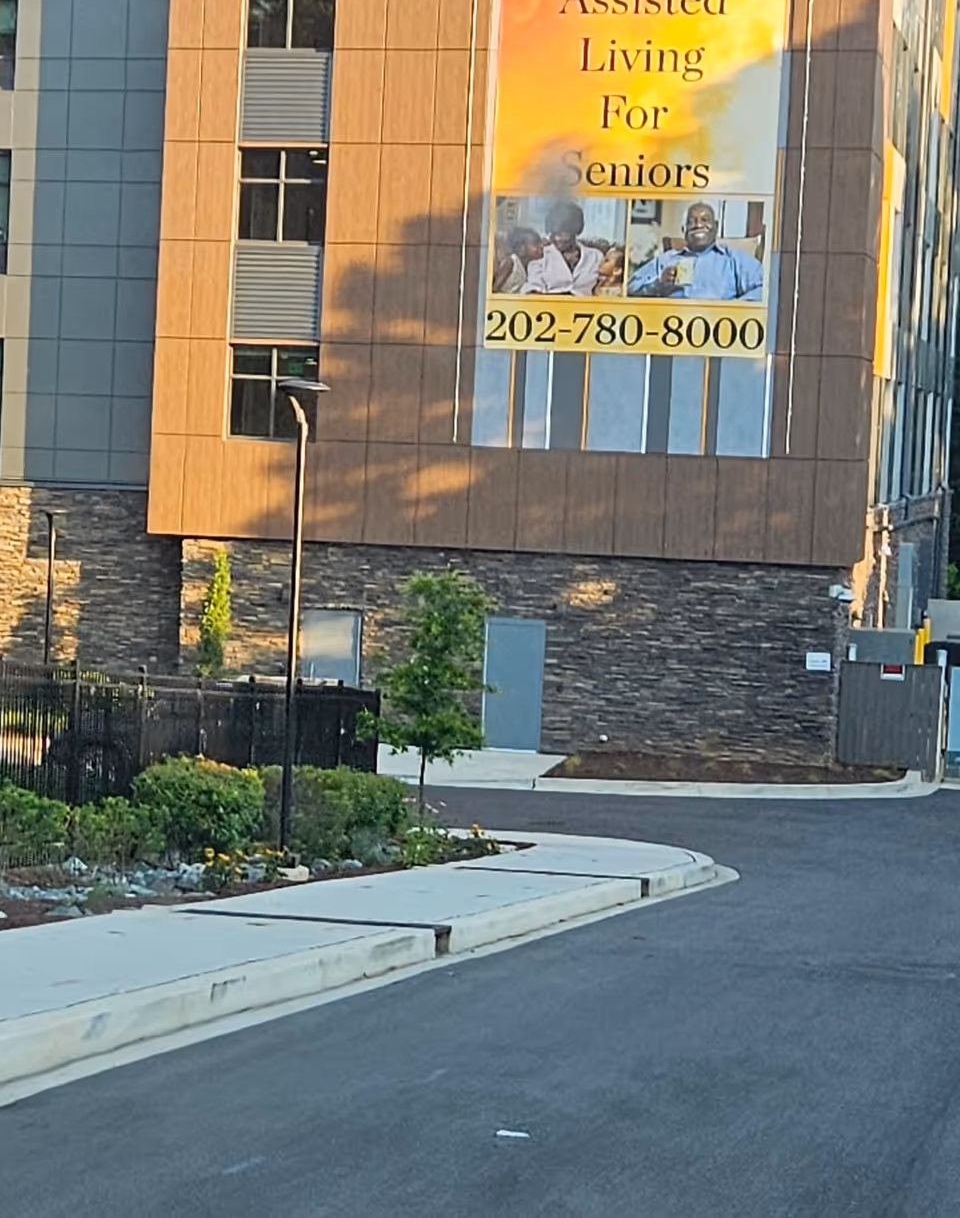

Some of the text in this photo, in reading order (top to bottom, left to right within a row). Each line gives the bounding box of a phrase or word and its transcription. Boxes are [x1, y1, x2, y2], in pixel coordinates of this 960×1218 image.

[580, 37, 706, 82] Living
[601, 95, 669, 130] For
[564, 149, 710, 188] Seniors
[485, 310, 765, 350] 202-780-8000
